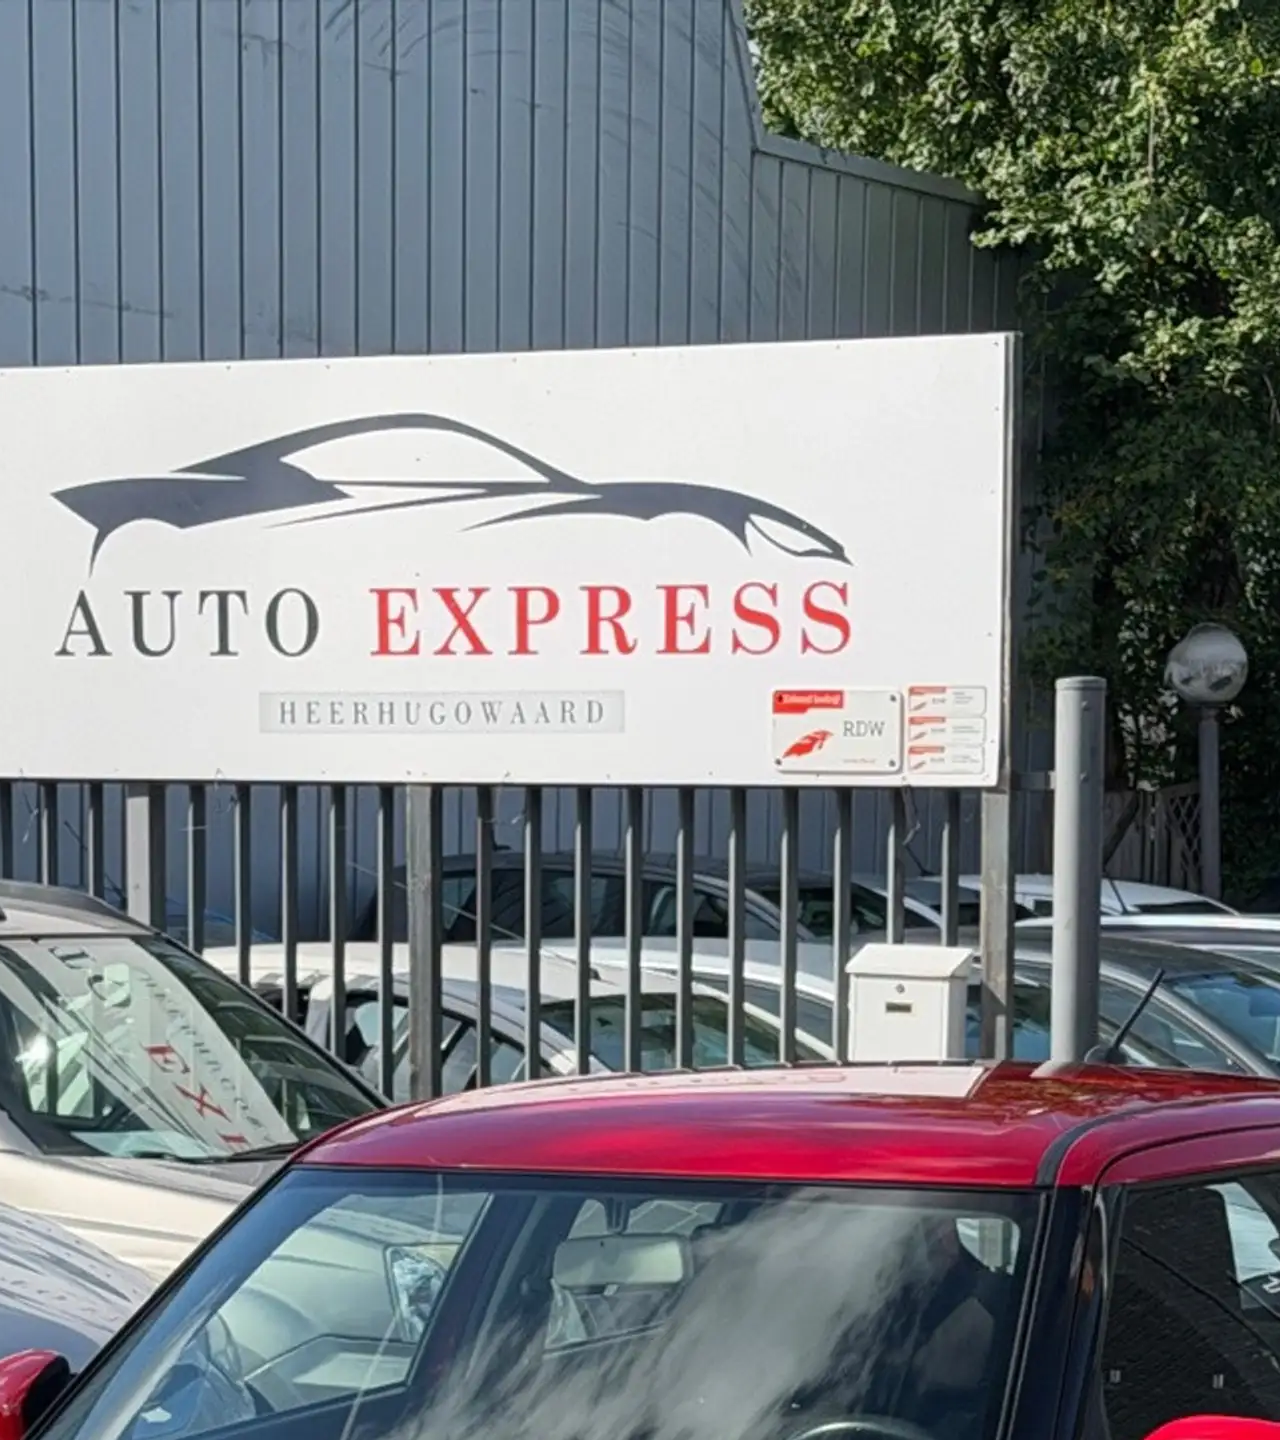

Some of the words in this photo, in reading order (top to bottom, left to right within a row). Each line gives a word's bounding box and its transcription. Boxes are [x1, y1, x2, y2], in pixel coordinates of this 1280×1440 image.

[54, 587, 320, 658] AUTO
[368, 580, 852, 656] EXPRESS
[279, 699, 605, 726] HEERHUGOWAARD
[843, 720, 885, 738] RDW
